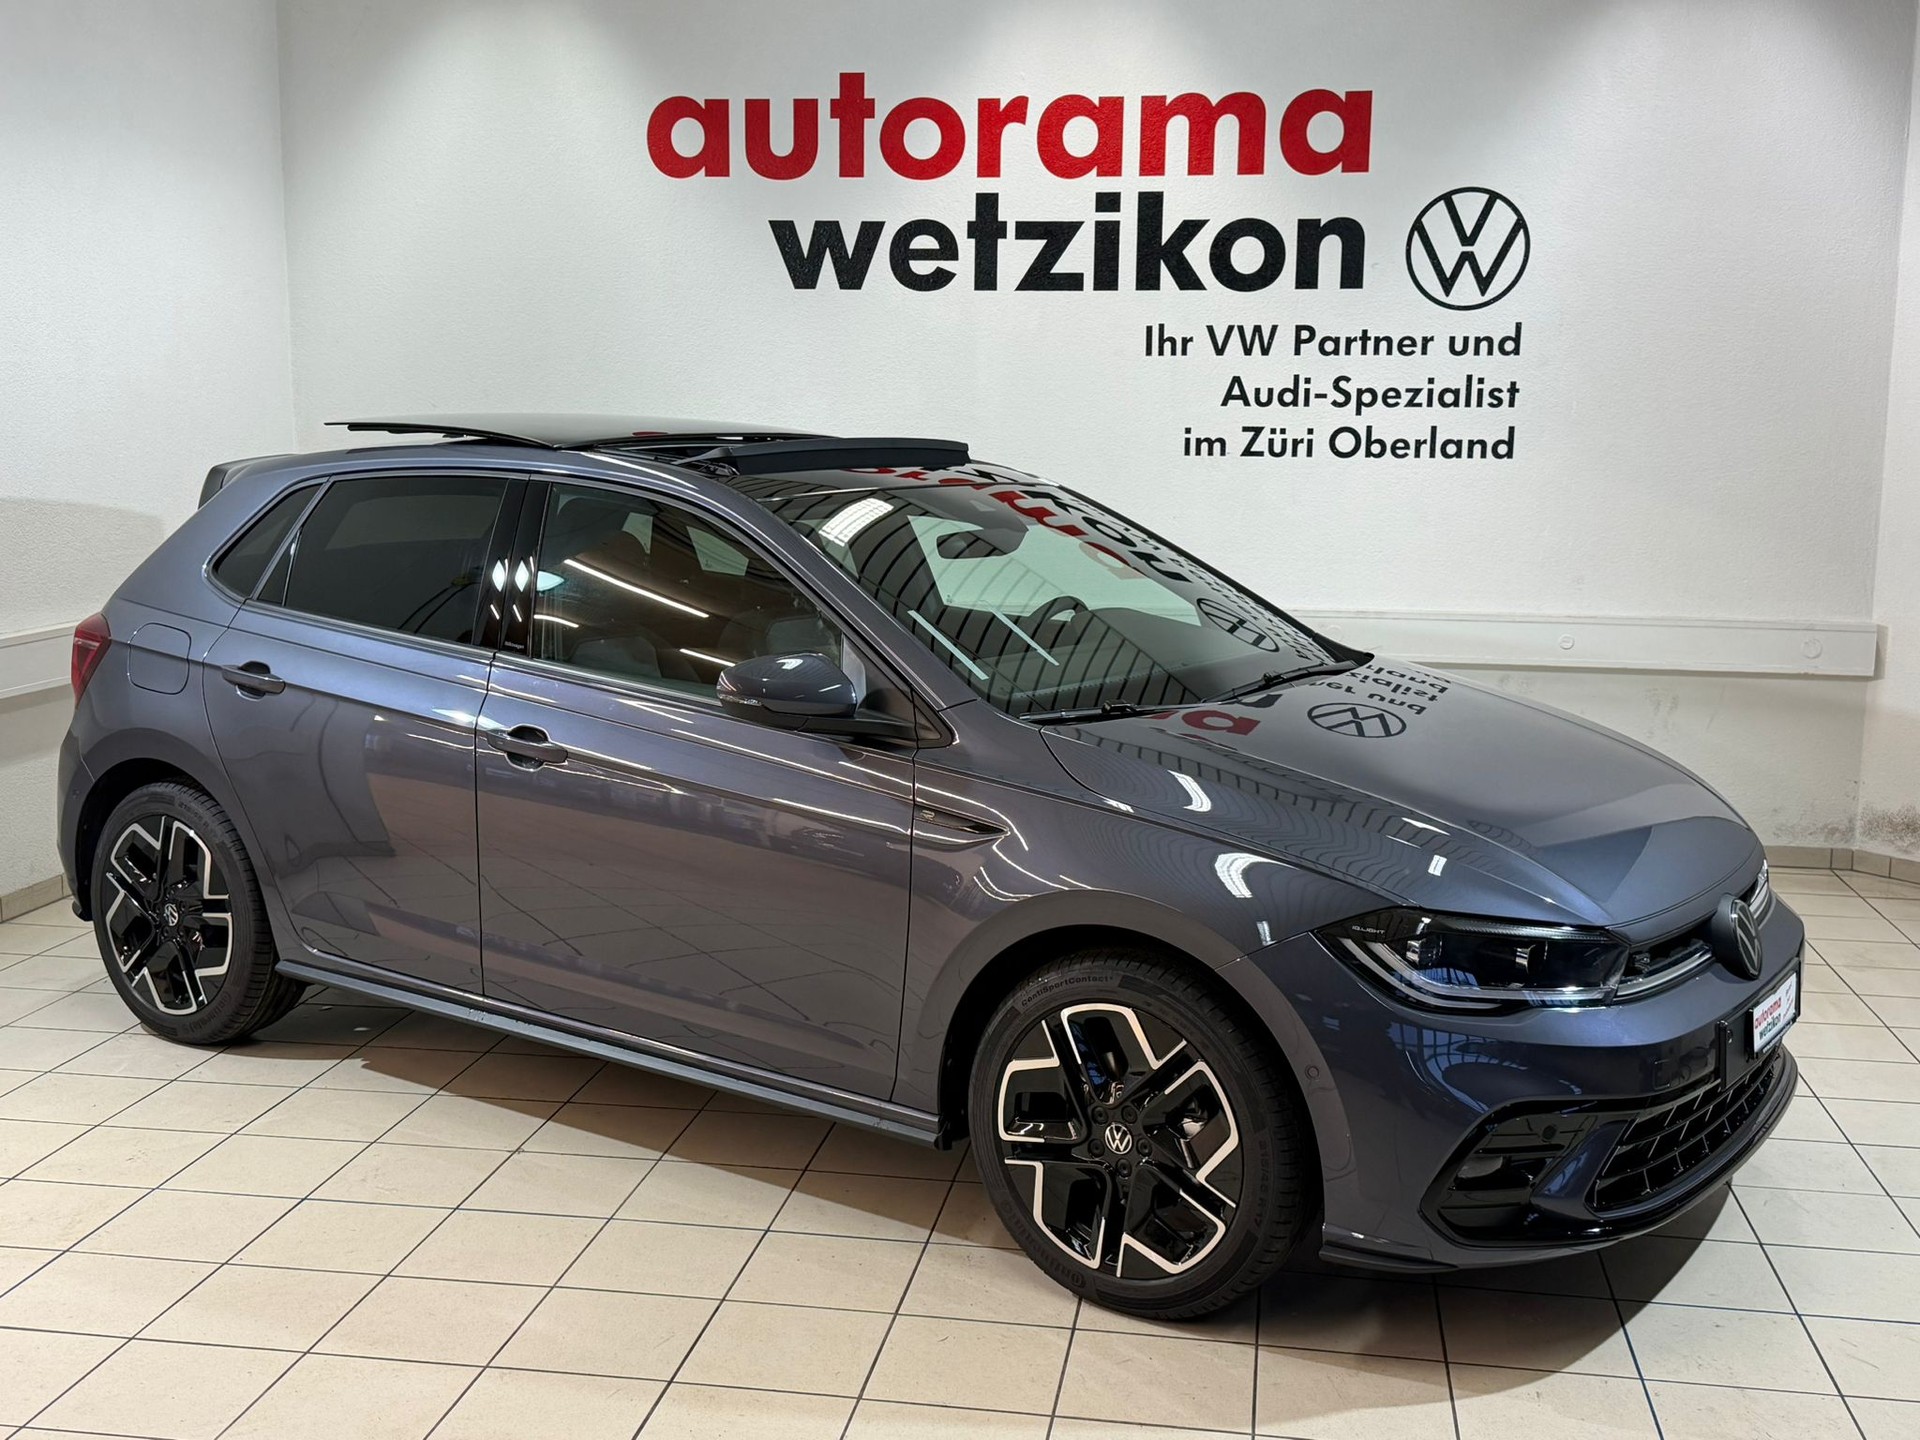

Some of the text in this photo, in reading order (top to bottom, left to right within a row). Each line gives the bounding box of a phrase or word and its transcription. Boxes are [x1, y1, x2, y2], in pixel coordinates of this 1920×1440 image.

[646, 72, 1373, 181] autorama
[768, 191, 1366, 292] wetzikon
[1145, 321, 1522, 357] Ihr VW Partner und
[1220, 375, 1520, 416] Audi-Spezialist
[1184, 425, 1515, 460] im Züri Oberland
